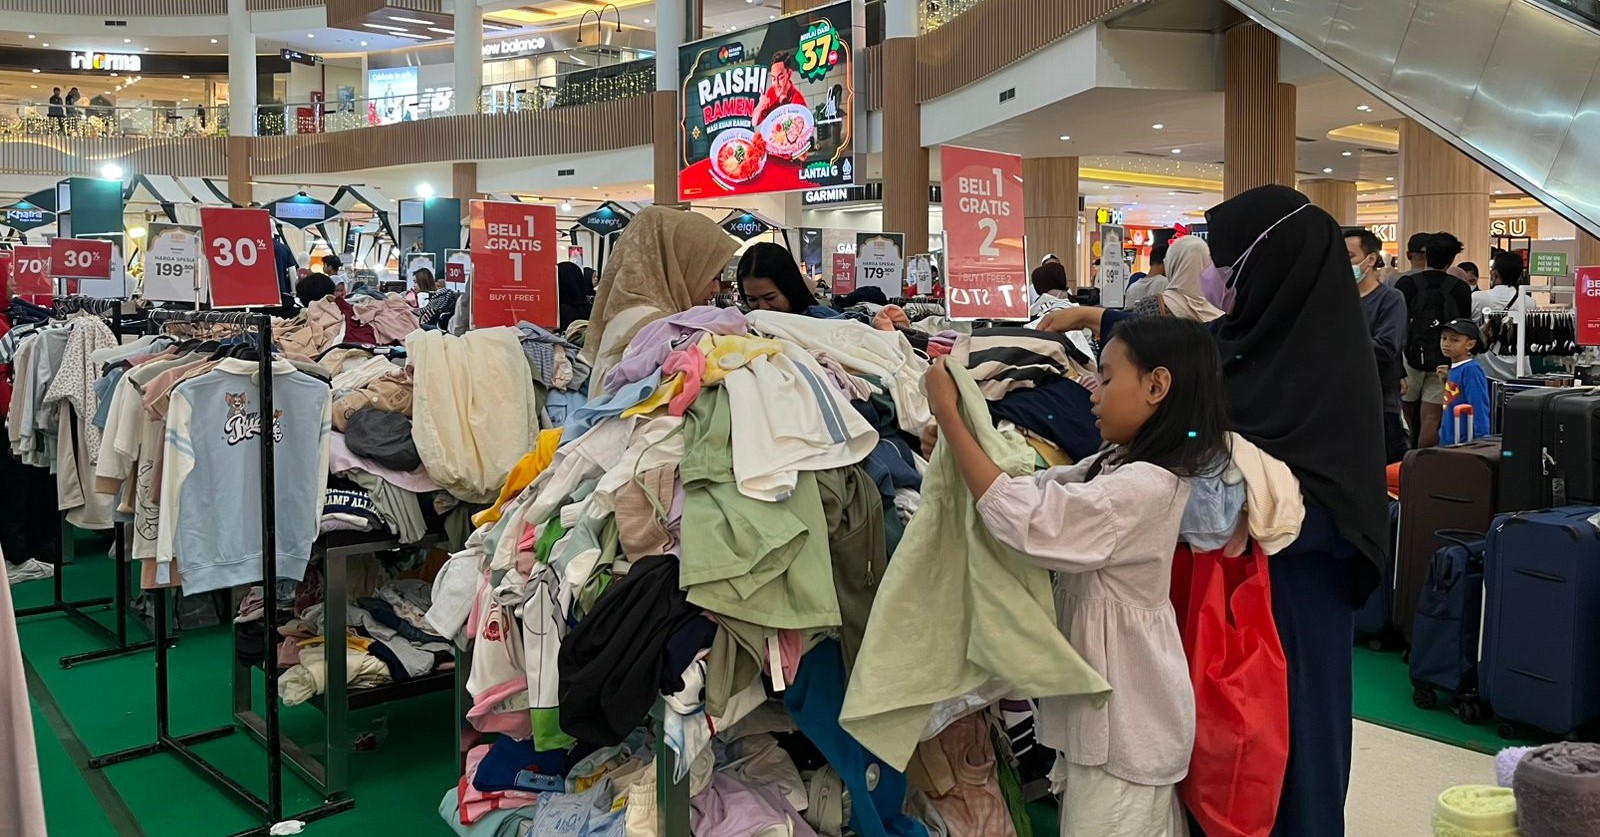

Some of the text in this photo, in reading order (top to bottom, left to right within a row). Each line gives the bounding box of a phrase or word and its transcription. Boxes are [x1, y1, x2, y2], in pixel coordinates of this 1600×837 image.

[501, 37, 546, 54] balance
[801, 34, 832, 71] 37
[71, 51, 141, 71] informa
[698, 67, 767, 105] RAISHI
[703, 97, 755, 125] RAMEN
[799, 165, 838, 180] LANTAI G
[959, 167, 1003, 198] BELI 1
[805, 188, 848, 203] GARMIN
[959, 197, 1010, 216] GRATIS
[487, 215, 535, 238] BELI 1
[978, 217, 999, 257] 2
[212, 237, 267, 267] 30%
[487, 237, 542, 252] GRATIS
[509, 252, 522, 282] 1
[963, 273, 978, 282] BUY
[986, 274, 1005, 283] FREE
[489, 293, 507, 301] BUY
